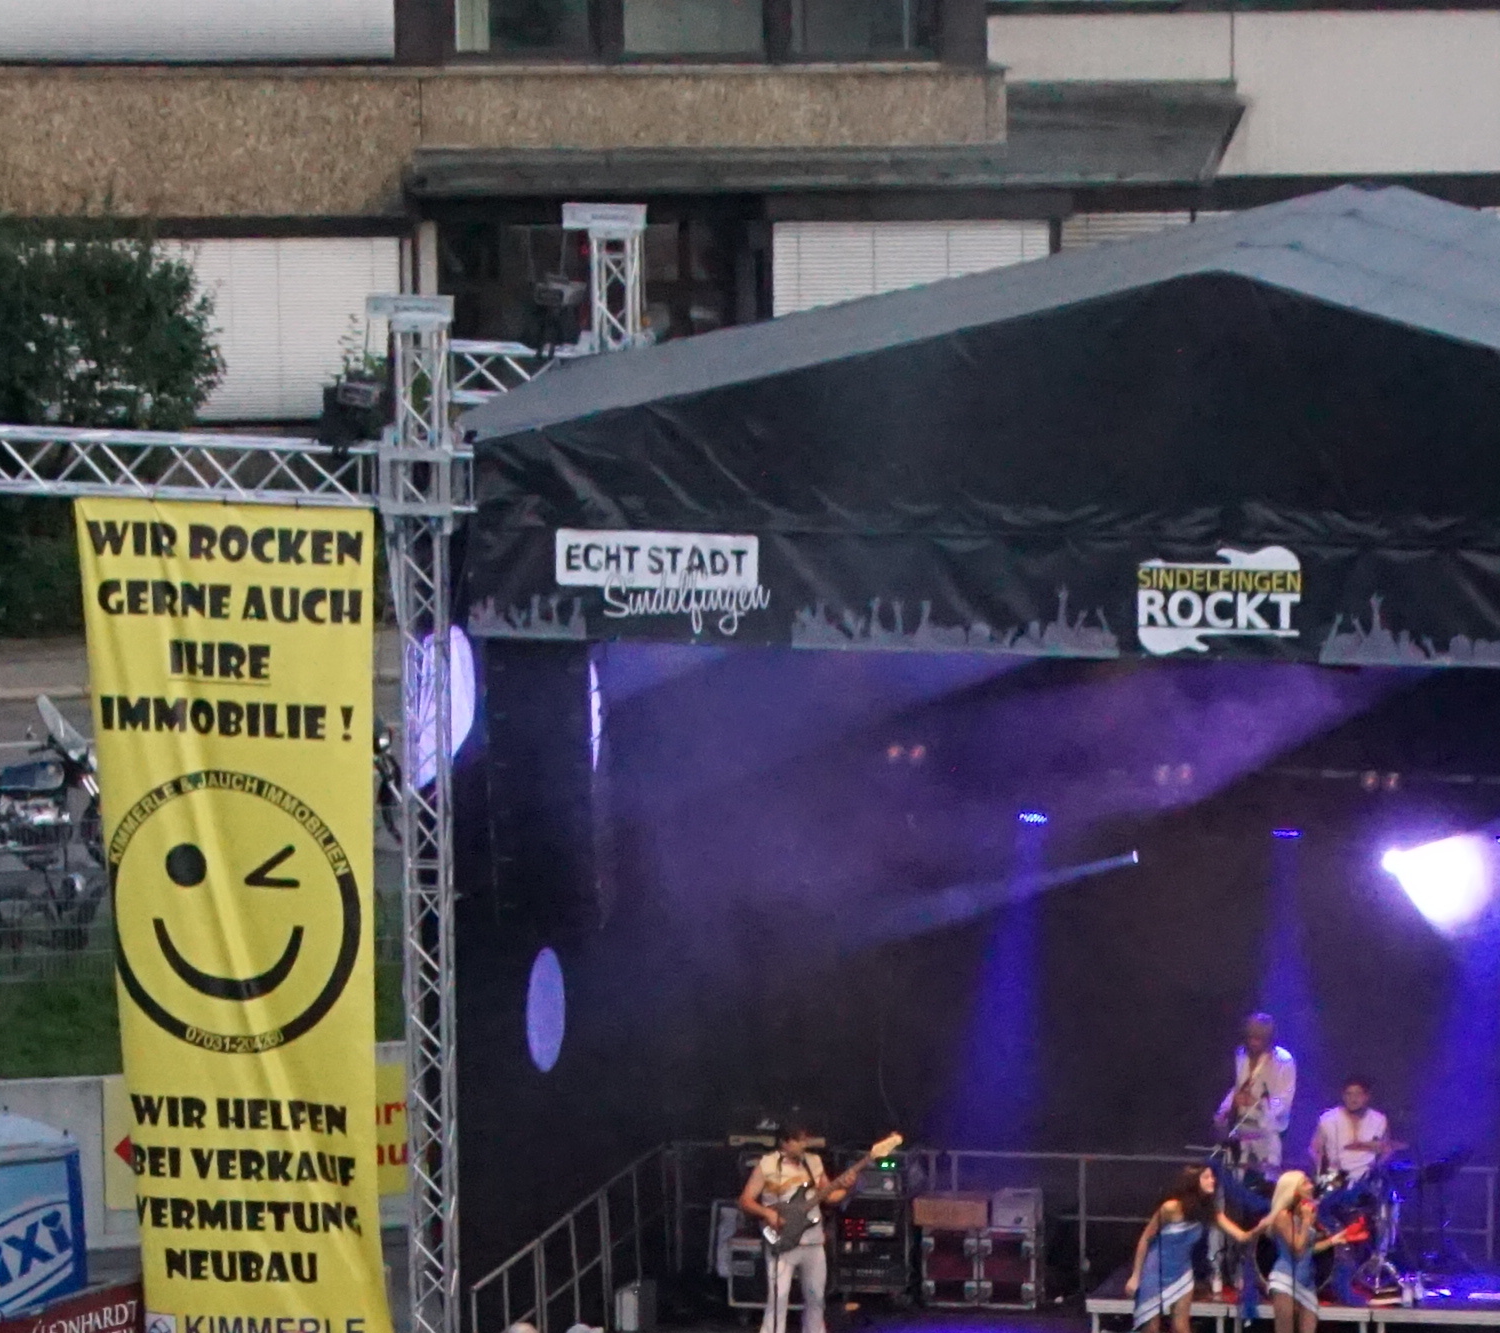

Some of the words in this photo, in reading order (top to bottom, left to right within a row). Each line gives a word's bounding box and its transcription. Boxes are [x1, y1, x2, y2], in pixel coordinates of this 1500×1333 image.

[86, 520, 177, 557] WIR
[189, 525, 364, 565] ROCKEN
[566, 544, 639, 572] ECHT
[648, 544, 749, 576] STADT
[1138, 568, 1301, 592] SINDELFINGEN
[98, 581, 231, 619] GERNE
[242, 586, 362, 624] AUCH
[603, 572, 770, 635] Sindelfingen
[1138, 590, 1301, 630] ROCKT
[169, 640, 272, 680] IHRE
[100, 697, 327, 740] IMMOBILIE
[342, 706, 354, 741] !
[109, 783, 178, 866] KIMMERLE
[199, 771, 258, 792] JAUCH
[260, 784, 349, 877] IMMOBILIEN
[131, 1093, 207, 1130] WIR
[217, 1098, 348, 1135] HELFEN
[133, 1145, 182, 1180] BEI
[192, 1148, 355, 1186] VERKAUF
[135, 1198, 362, 1236] VERMIETUNG
[166, 1248, 318, 1284] NEUBAU
